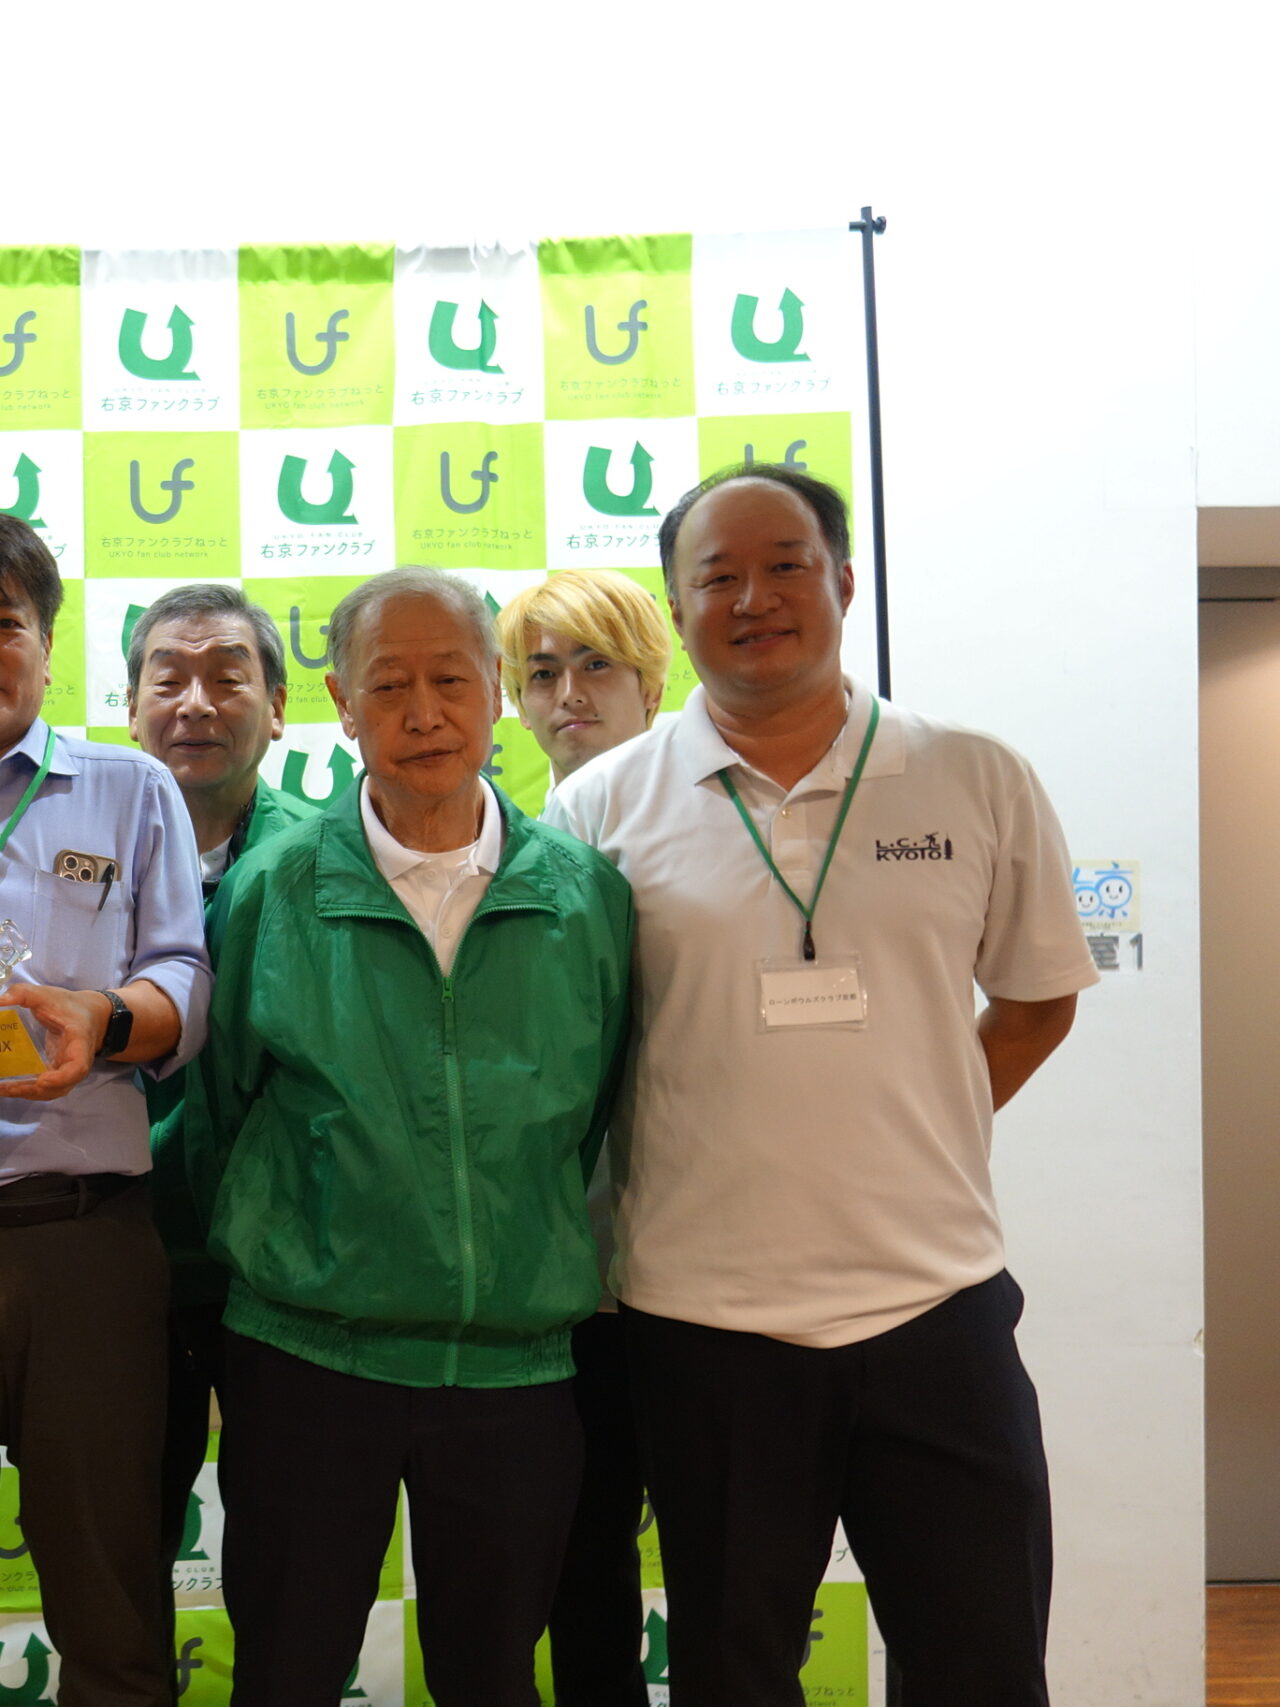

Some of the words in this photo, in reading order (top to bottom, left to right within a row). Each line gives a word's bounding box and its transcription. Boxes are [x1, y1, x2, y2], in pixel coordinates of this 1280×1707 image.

[716, 377, 832, 397] 右京ファンクラブ
[411, 387, 525, 406] 右京ファンクラブ
[101, 396, 221, 412] 右京ファンクラブ
[412, 528, 533, 540] 右京ファンクラブねっと
[101, 536, 228, 548] 右京ファンクラブねっと
[420, 541, 444, 550] UKYO
[447, 541, 461, 549] fan
[109, 550, 133, 559] UKYO
[137, 550, 151, 559] fan
[154, 550, 172, 559] club
[261, 540, 376, 559] 右京ファンクラブ
[876, 849, 942, 861] KYOTO
[186, 1566, 216, 1574] CLUB
